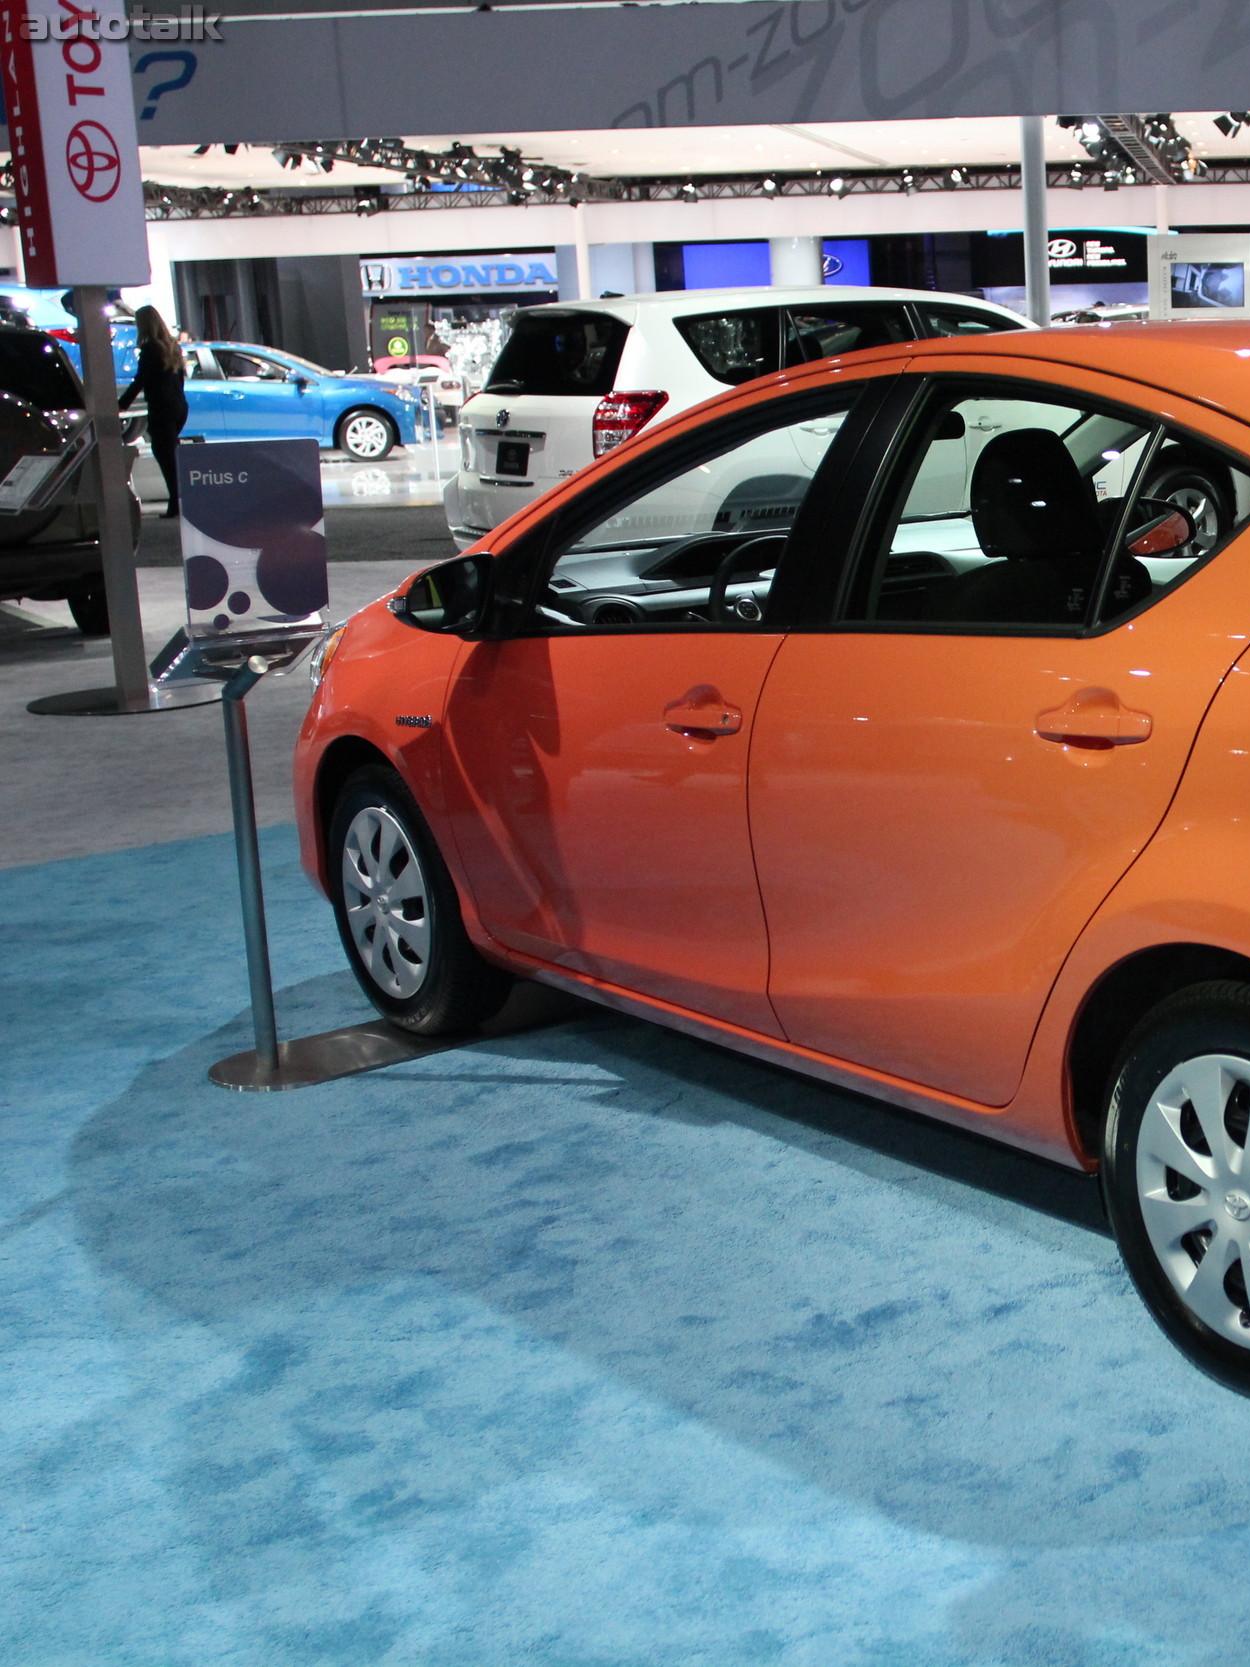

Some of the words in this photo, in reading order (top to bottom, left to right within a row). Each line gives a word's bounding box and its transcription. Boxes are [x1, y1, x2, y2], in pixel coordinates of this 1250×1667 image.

[398, 262, 560, 291] HONDA
[189, 469, 234, 487] Prius
[238, 471, 249, 484] c
